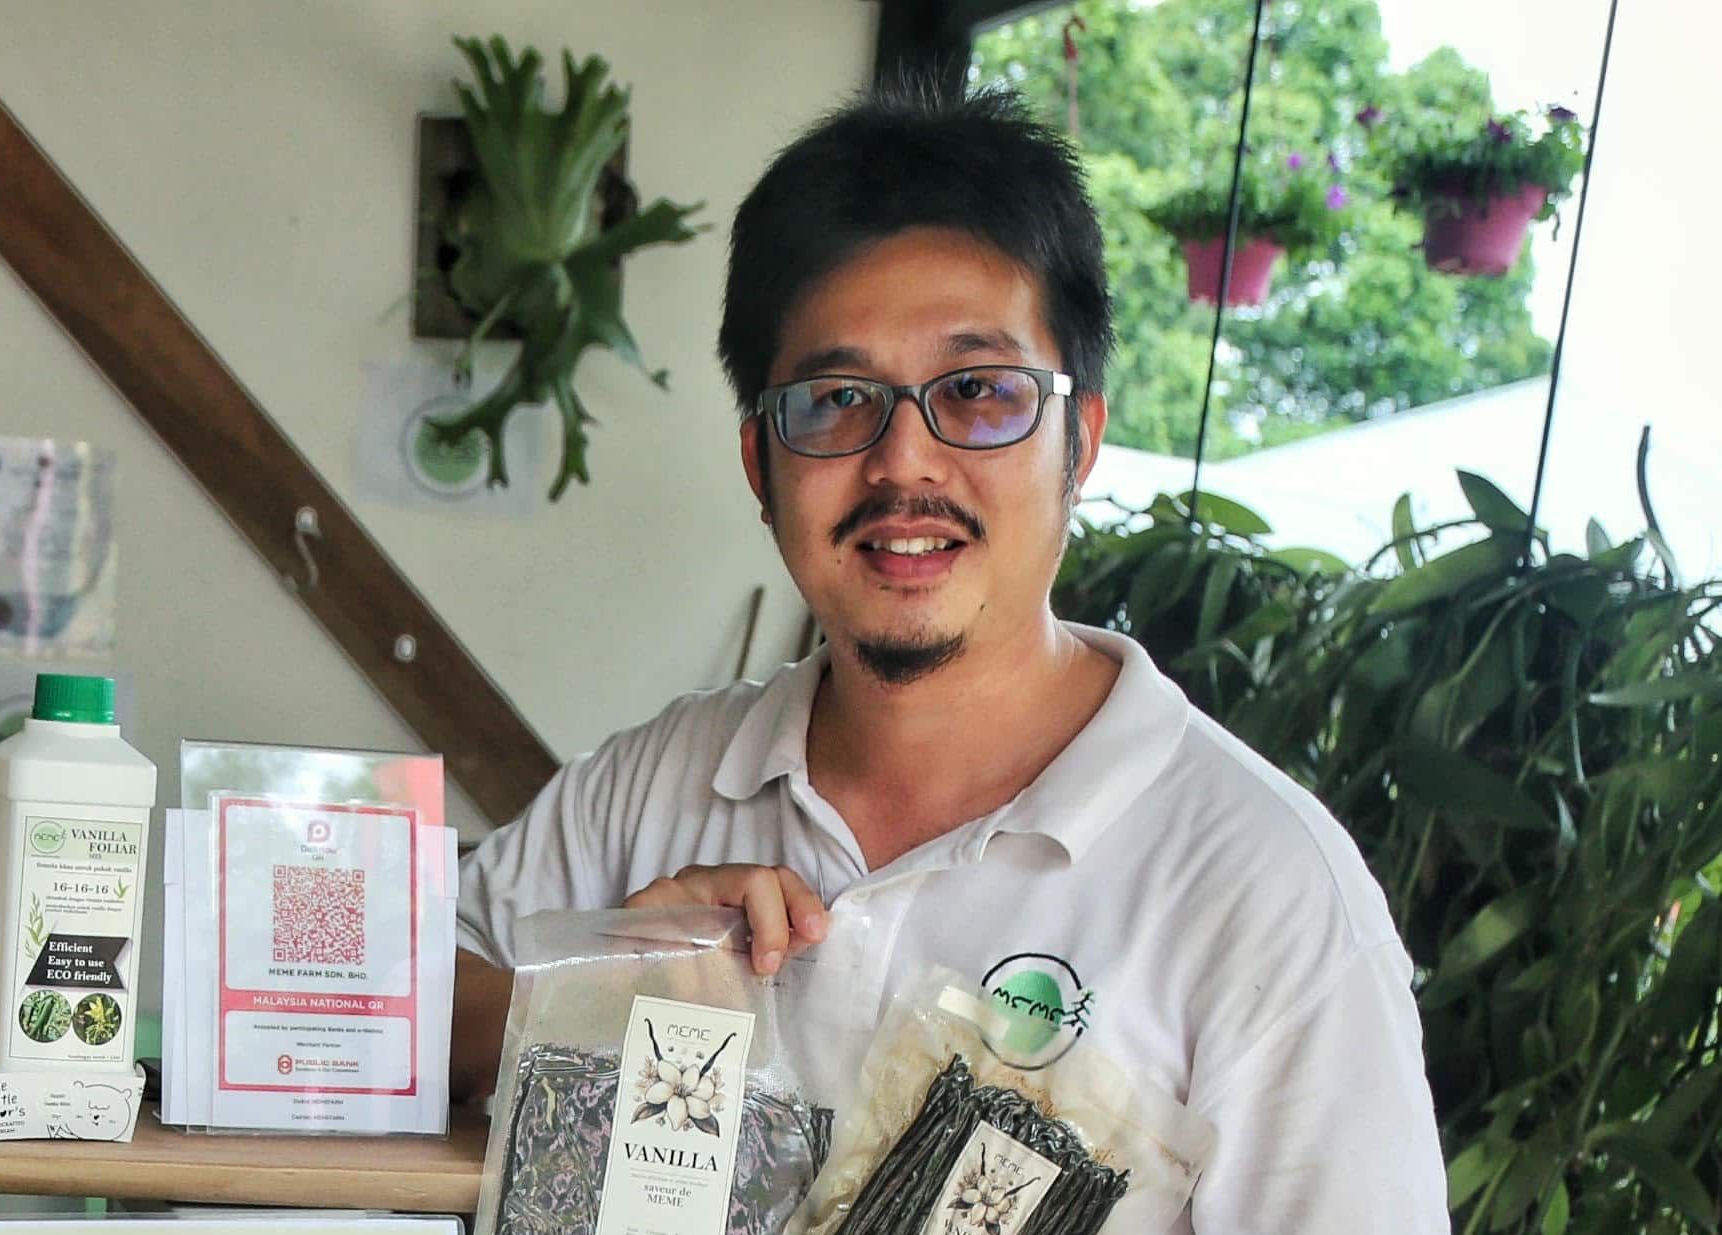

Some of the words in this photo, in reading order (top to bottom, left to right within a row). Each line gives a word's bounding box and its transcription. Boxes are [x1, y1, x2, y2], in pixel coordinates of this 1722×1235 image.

[71, 828, 127, 842] VANILLA
[89, 841, 137, 855] FOLIAR
[53, 882, 110, 895] 16-16-16
[49, 941, 93, 953] Efficient
[48, 956, 72, 968] Easy
[74, 958, 86, 966] to
[88, 960, 105, 968] use
[47, 969, 71, 980] ECO
[74, 971, 112, 984] friendly
[268, 968, 294, 976] MEME
[297, 969, 322, 978] FARM
[253, 996, 307, 1007] MALAYSIA
[310, 998, 366, 1009] NATIONAL
[368, 1000, 384, 1010] QR
[624, 1142, 718, 1172] VANILLA
[644, 1184, 677, 1196] saveur
[679, 1186, 692, 1197] de
[647, 1193, 685, 1207] MEME
